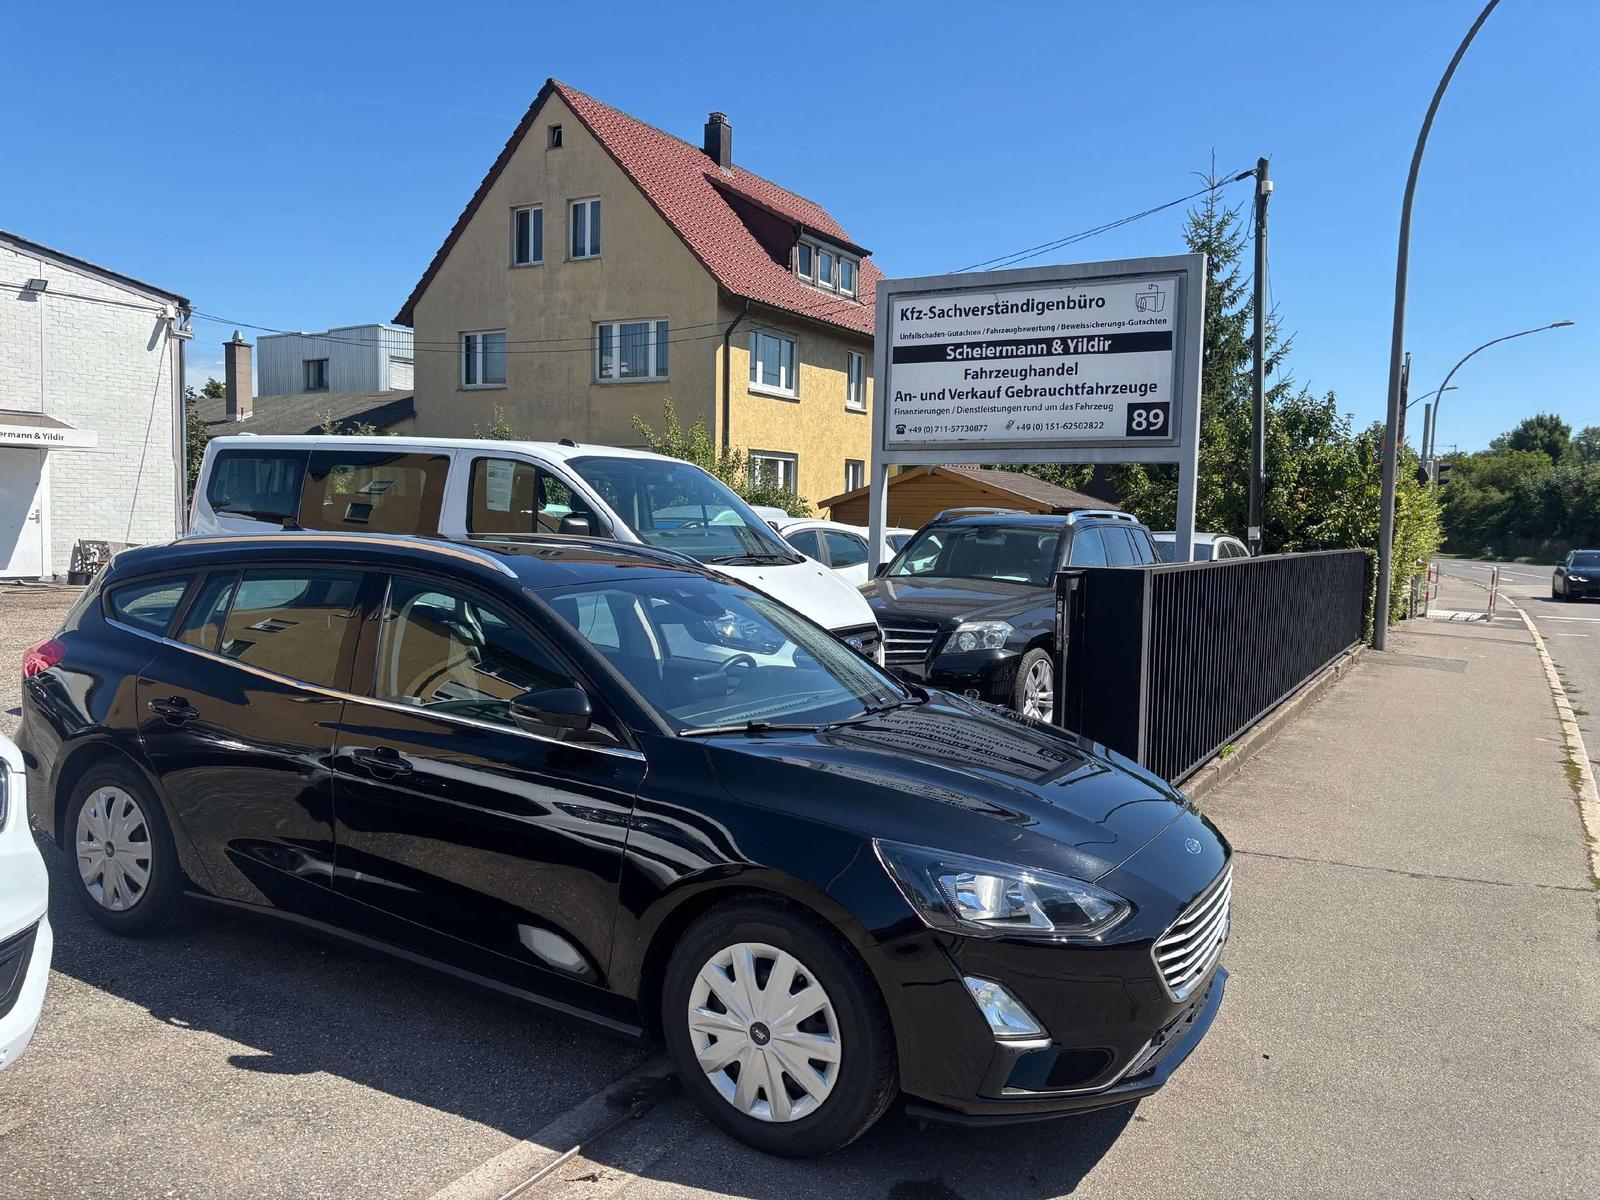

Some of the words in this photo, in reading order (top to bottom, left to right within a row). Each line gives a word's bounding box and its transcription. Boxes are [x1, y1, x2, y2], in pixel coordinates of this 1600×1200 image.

[900, 294, 1106, 321] Kfz-Sachverständigenbüro
[900, 328, 981, 340] Unfallschaden-Gutachten
[986, 325, 1055, 335] Fahrzeugbewertung
[1061, 318, 1167, 330] Beweissicherungs-Gutachten
[946, 343, 1047, 360] Scheiermann
[1051, 339, 1064, 354] &
[1067, 337, 1112, 353] Yildir
[964, 362, 1078, 381] Fahrzeughandel
[894, 390, 918, 402] An-
[920, 388, 946, 401] und
[948, 386, 1003, 400] Verkauf
[1005, 382, 1158, 399] Gebrauchtfahrzeuge
[894, 407, 950, 416] Finanzierungen
[956, 405, 1022, 415] Dienstleistungen
[1023, 403, 1042, 412] rund
[1059, 403, 1074, 411] das
[1075, 402, 1114, 412] Fahrzeug
[908, 426, 922, 434] +49
[923, 425, 933, 435] (0)
[935, 424, 988, 433] 711-57730877
[1016, 422, 1031, 431] +49
[1032, 422, 1043, 431] (0)
[1131, 408, 1165, 431] 89
[34, 432, 41, 440] &
[42, 432, 64, 441] Yildir
